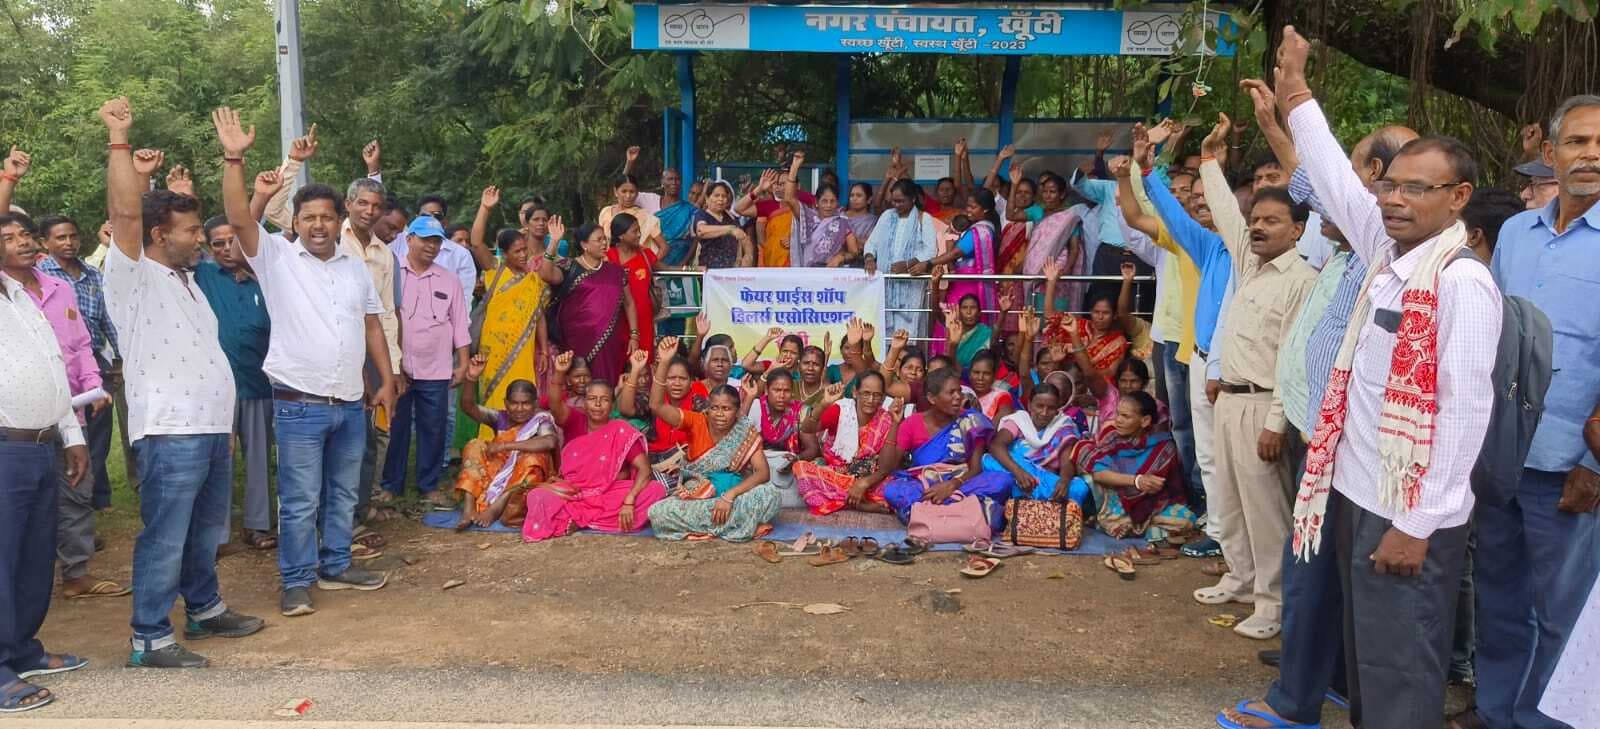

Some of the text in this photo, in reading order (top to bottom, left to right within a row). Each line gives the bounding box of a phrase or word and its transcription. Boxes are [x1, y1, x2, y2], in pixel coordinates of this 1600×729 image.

[805, 9, 1064, 41] नगर पंचायत, खूँटी
[840, 38, 874, 48] स्वच्छ
[740, 286, 847, 305] फेयर प्राईस शॉप
